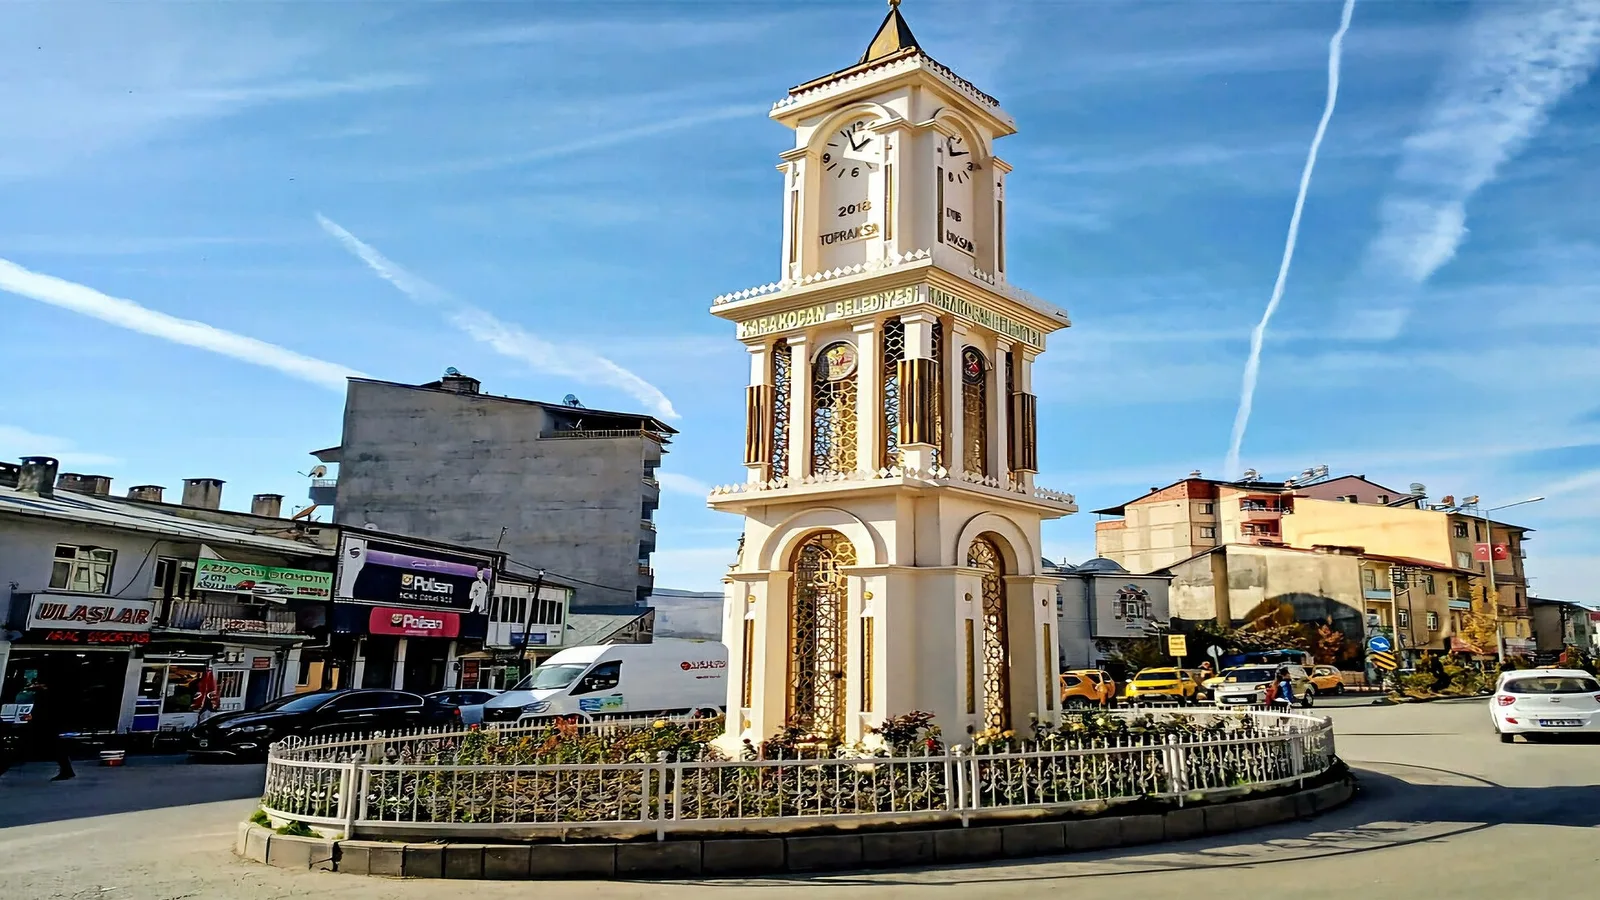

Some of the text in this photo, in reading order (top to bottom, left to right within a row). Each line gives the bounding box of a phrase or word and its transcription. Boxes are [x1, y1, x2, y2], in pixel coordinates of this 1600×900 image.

[822, 152, 831, 164] 9
[851, 167, 859, 178] 6
[838, 201, 872, 217] 2018
[414, 575, 454, 595] Polisan
[402, 613, 443, 630] Polisan
